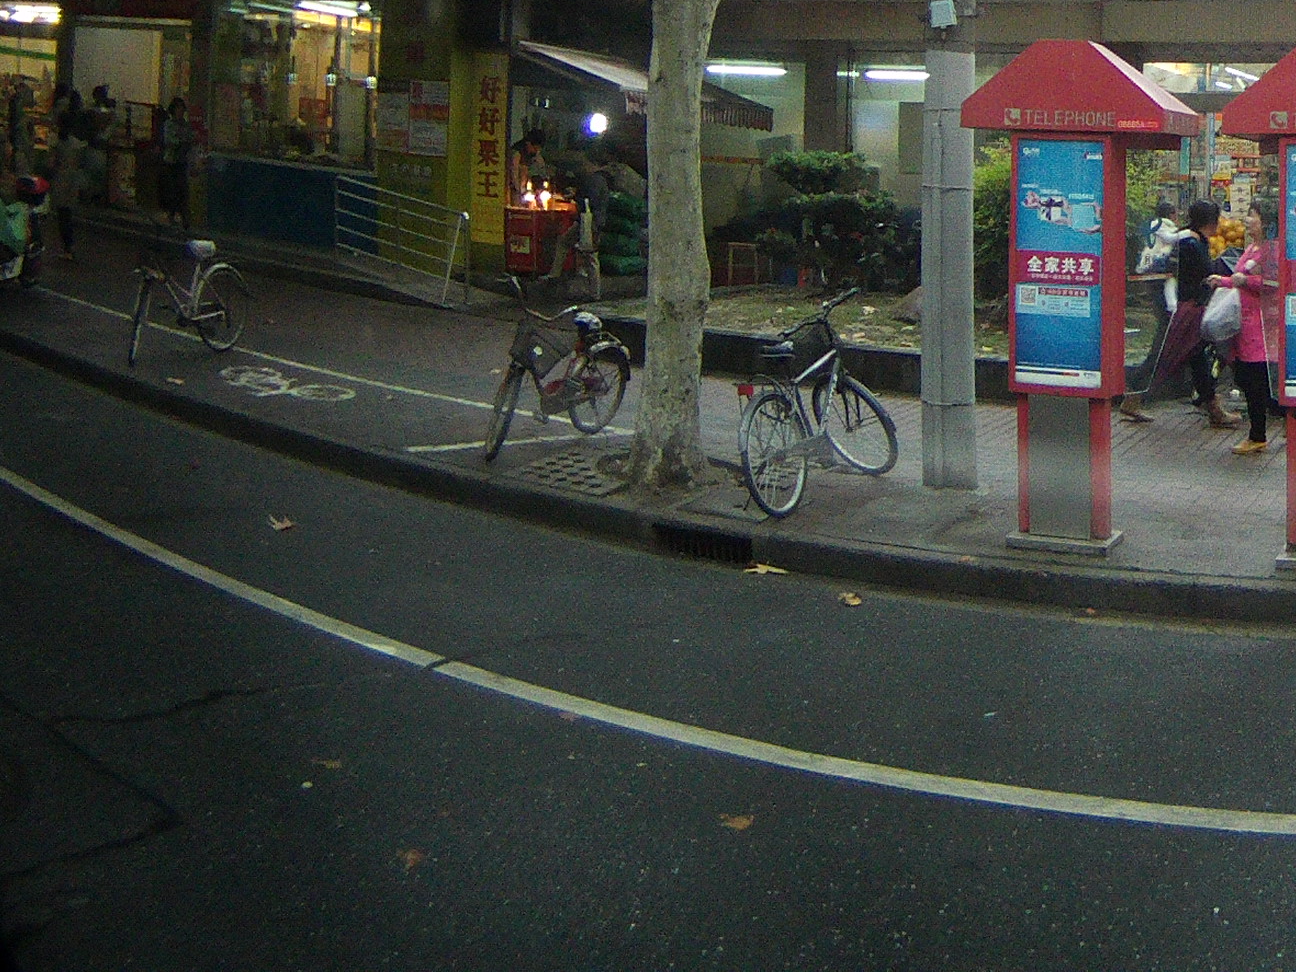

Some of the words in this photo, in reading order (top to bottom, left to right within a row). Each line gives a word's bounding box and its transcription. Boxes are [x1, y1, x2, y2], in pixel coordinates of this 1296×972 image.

[1024, 109, 1116, 128] TELEPHONE
[1026, 254, 1095, 276] 全家共享
